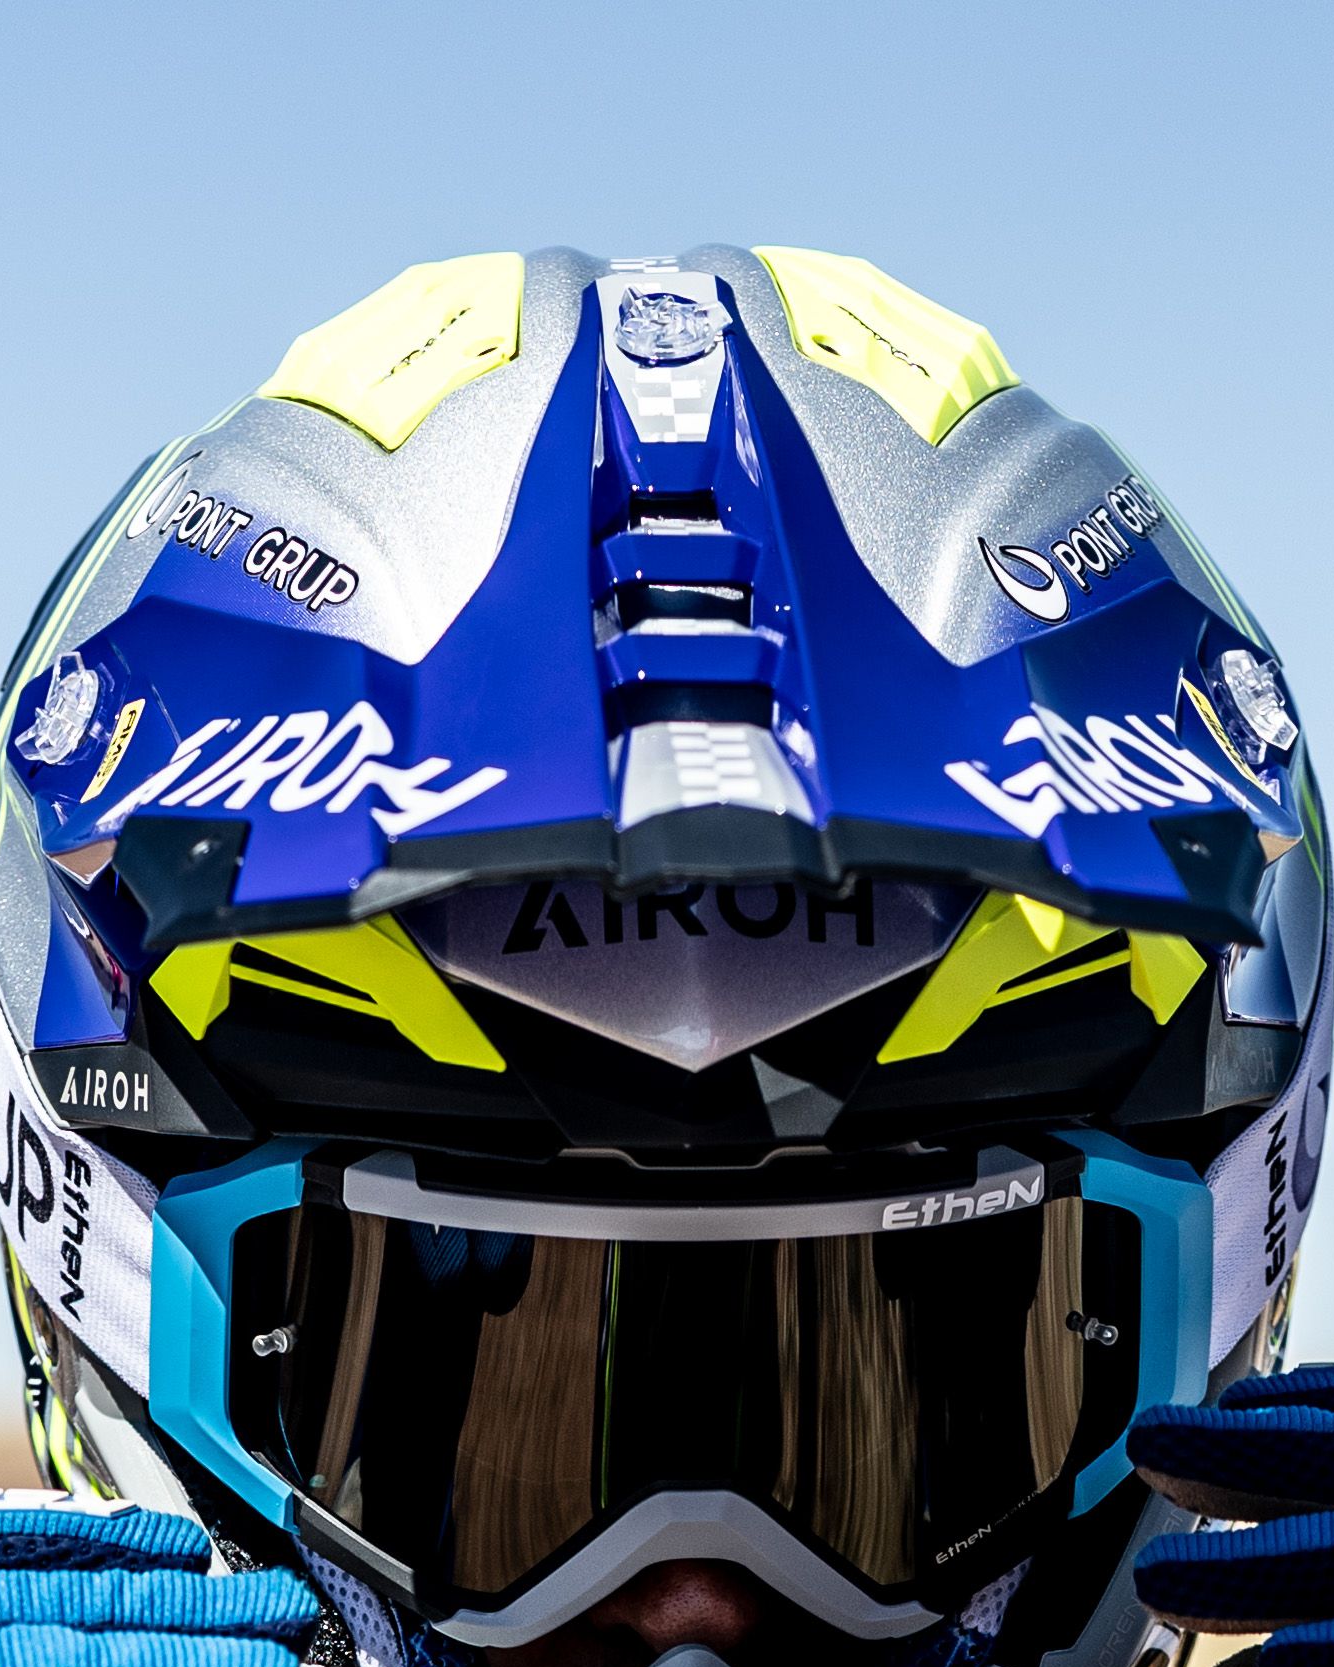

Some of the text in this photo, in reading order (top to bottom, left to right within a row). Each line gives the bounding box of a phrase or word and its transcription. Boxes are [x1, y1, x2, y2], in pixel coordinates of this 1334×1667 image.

[166, 491, 358, 611] PONT GRUP
[1052, 506, 1132, 588] PONT
[502, 878, 875, 955] AIROH
[60, 1066, 150, 1112] AIROH
[880, 1174, 1041, 1232] EtheN
